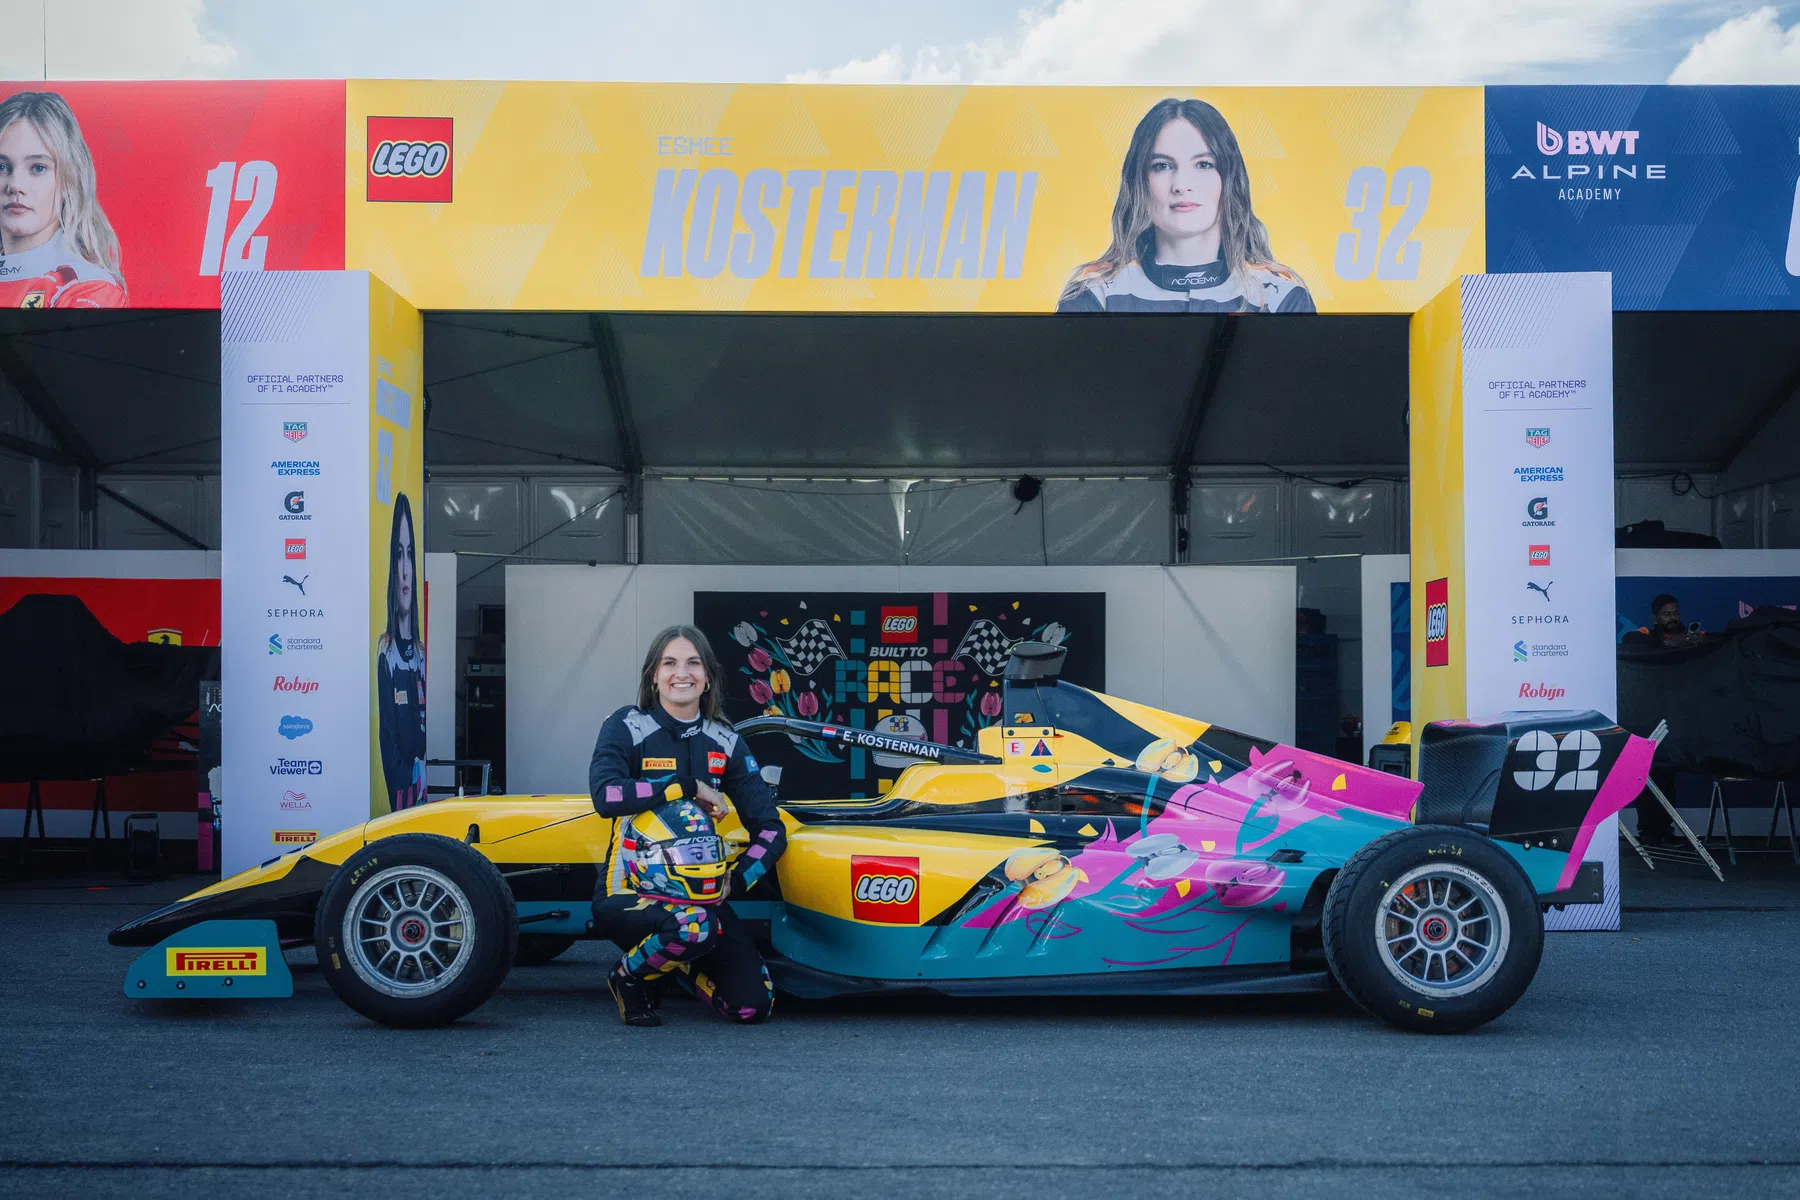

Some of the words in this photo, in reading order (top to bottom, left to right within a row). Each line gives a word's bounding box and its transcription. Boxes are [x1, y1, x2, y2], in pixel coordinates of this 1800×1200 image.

[657, 136, 733, 156] ESMEE
[1568, 131, 1639, 155] BWT
[370, 140, 450, 178] LEGO
[1511, 165, 1666, 179] ALPINE
[1558, 188, 1622, 200] ACADEMY
[199, 160, 278, 276] 12
[1334, 166, 1432, 281] 32
[640, 168, 1038, 280] KOSTERMAN
[247, 375, 293, 383] OFFICIAL
[296, 374, 344, 383] PARTNERS
[257, 385, 269, 393] OF
[272, 385, 284, 393] F1
[1488, 381, 1536, 389] OFFICIAL
[1538, 380, 1587, 389] PARTNERS
[1499, 391, 1510, 399] OF
[1513, 391, 1525, 399] F1
[285, 431, 306, 440] HEUER
[1527, 437, 1549, 446] HEUER
[1513, 467, 1563, 475] AMERICAN
[287, 544, 304, 553] LEGO
[1530, 551, 1549, 559] LEGO
[267, 609, 324, 617] SEPHORA
[882, 616, 917, 633] LEGO
[1427, 602, 1447, 642] LEGO
[1511, 615, 1569, 624] SEPHORA
[869, 647, 908, 657] BUILT
[909, 647, 928, 657] TO
[1532, 643, 1567, 651] standard
[1532, 649, 1568, 657] chartered
[273, 675, 320, 694] Robijn
[835, 660, 966, 704] RACE
[1518, 682, 1565, 701] Robijn
[843, 730, 854, 742] E.
[857, 733, 940, 758] KOSTERMAN
[1011, 742, 1020, 753] E
[278, 758, 307, 767] Team
[645, 760, 673, 768] PIRELLI
[1513, 729, 1602, 791] 32
[269, 766, 307, 775] Viewer
[275, 831, 316, 842] PIRELLI
[855, 874, 917, 905] LEGO
[176, 952, 258, 971] PIRELLI
